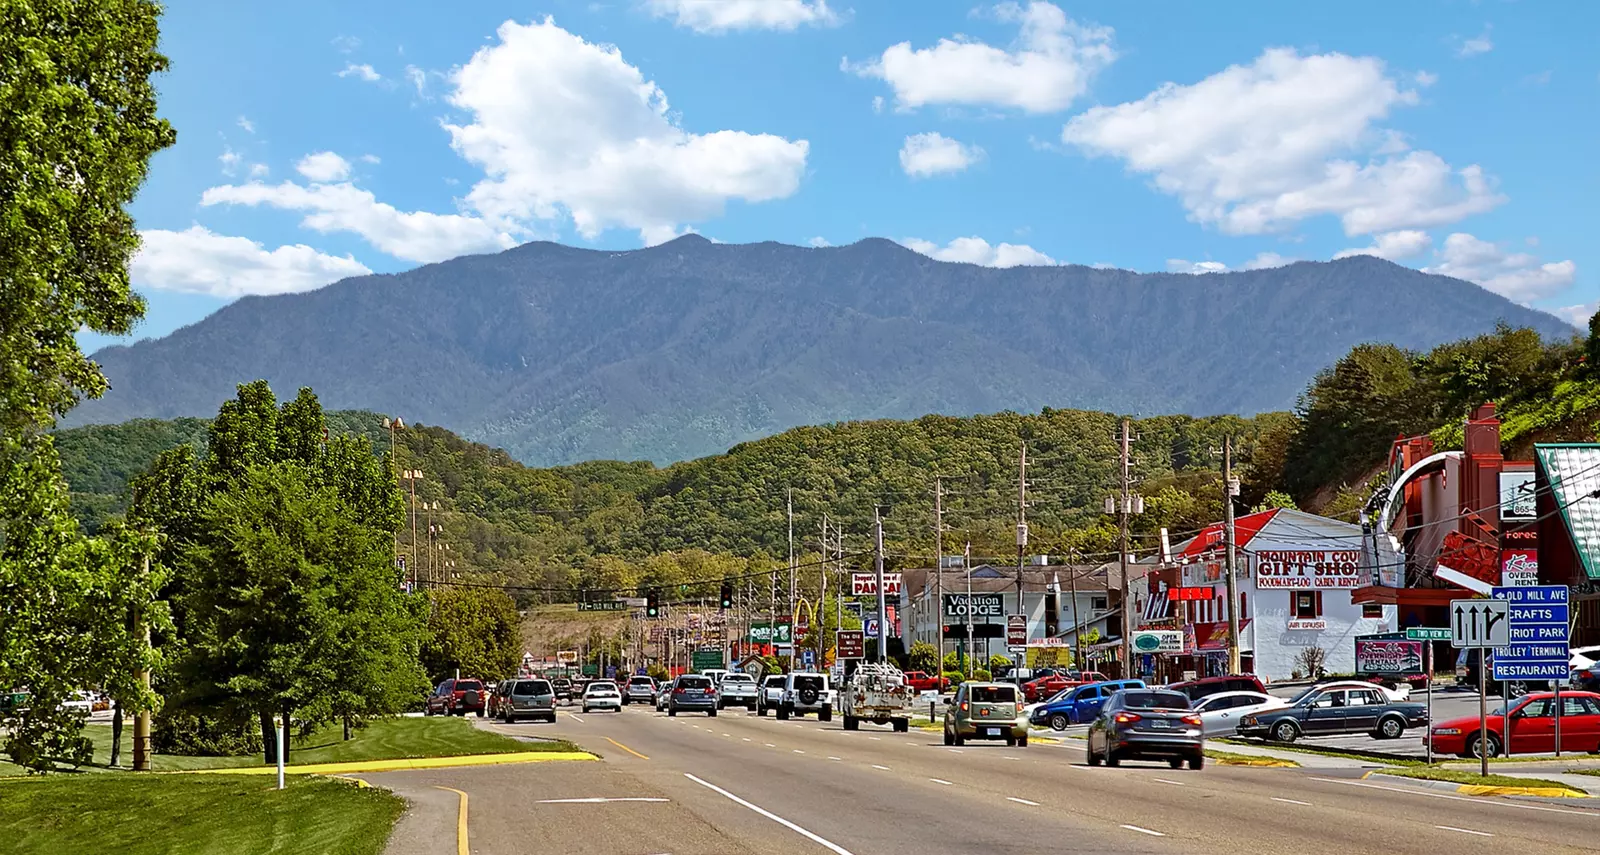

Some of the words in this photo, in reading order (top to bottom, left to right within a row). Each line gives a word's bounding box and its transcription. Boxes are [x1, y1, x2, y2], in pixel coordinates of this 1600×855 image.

[1260, 551, 1325, 562] MOUNTAIN
[1332, 551, 1360, 562] COU
[1259, 562, 1306, 576] GIFT
[1314, 562, 1359, 576] SHO
[1314, 577, 1335, 587] CABIN
[854, 583, 901, 593] PANA
[950, 595, 999, 605] Vacation
[1507, 591, 1523, 600] OLD
[1527, 591, 1545, 600] MILL
[1550, 590, 1565, 599] AVE
[948, 605, 1000, 615] LODGE
[1509, 609, 1552, 619] CRAFTS
[1289, 621, 1300, 629] AIR
[1302, 621, 1325, 629] BRUSH
[1429, 630, 1443, 638] VIEW
[1539, 628, 1565, 637] PARK
[1496, 647, 1526, 656] TROLLEY
[1531, 647, 1566, 656] TERMINAL
[1497, 665, 1567, 675] RESTAURANTS
